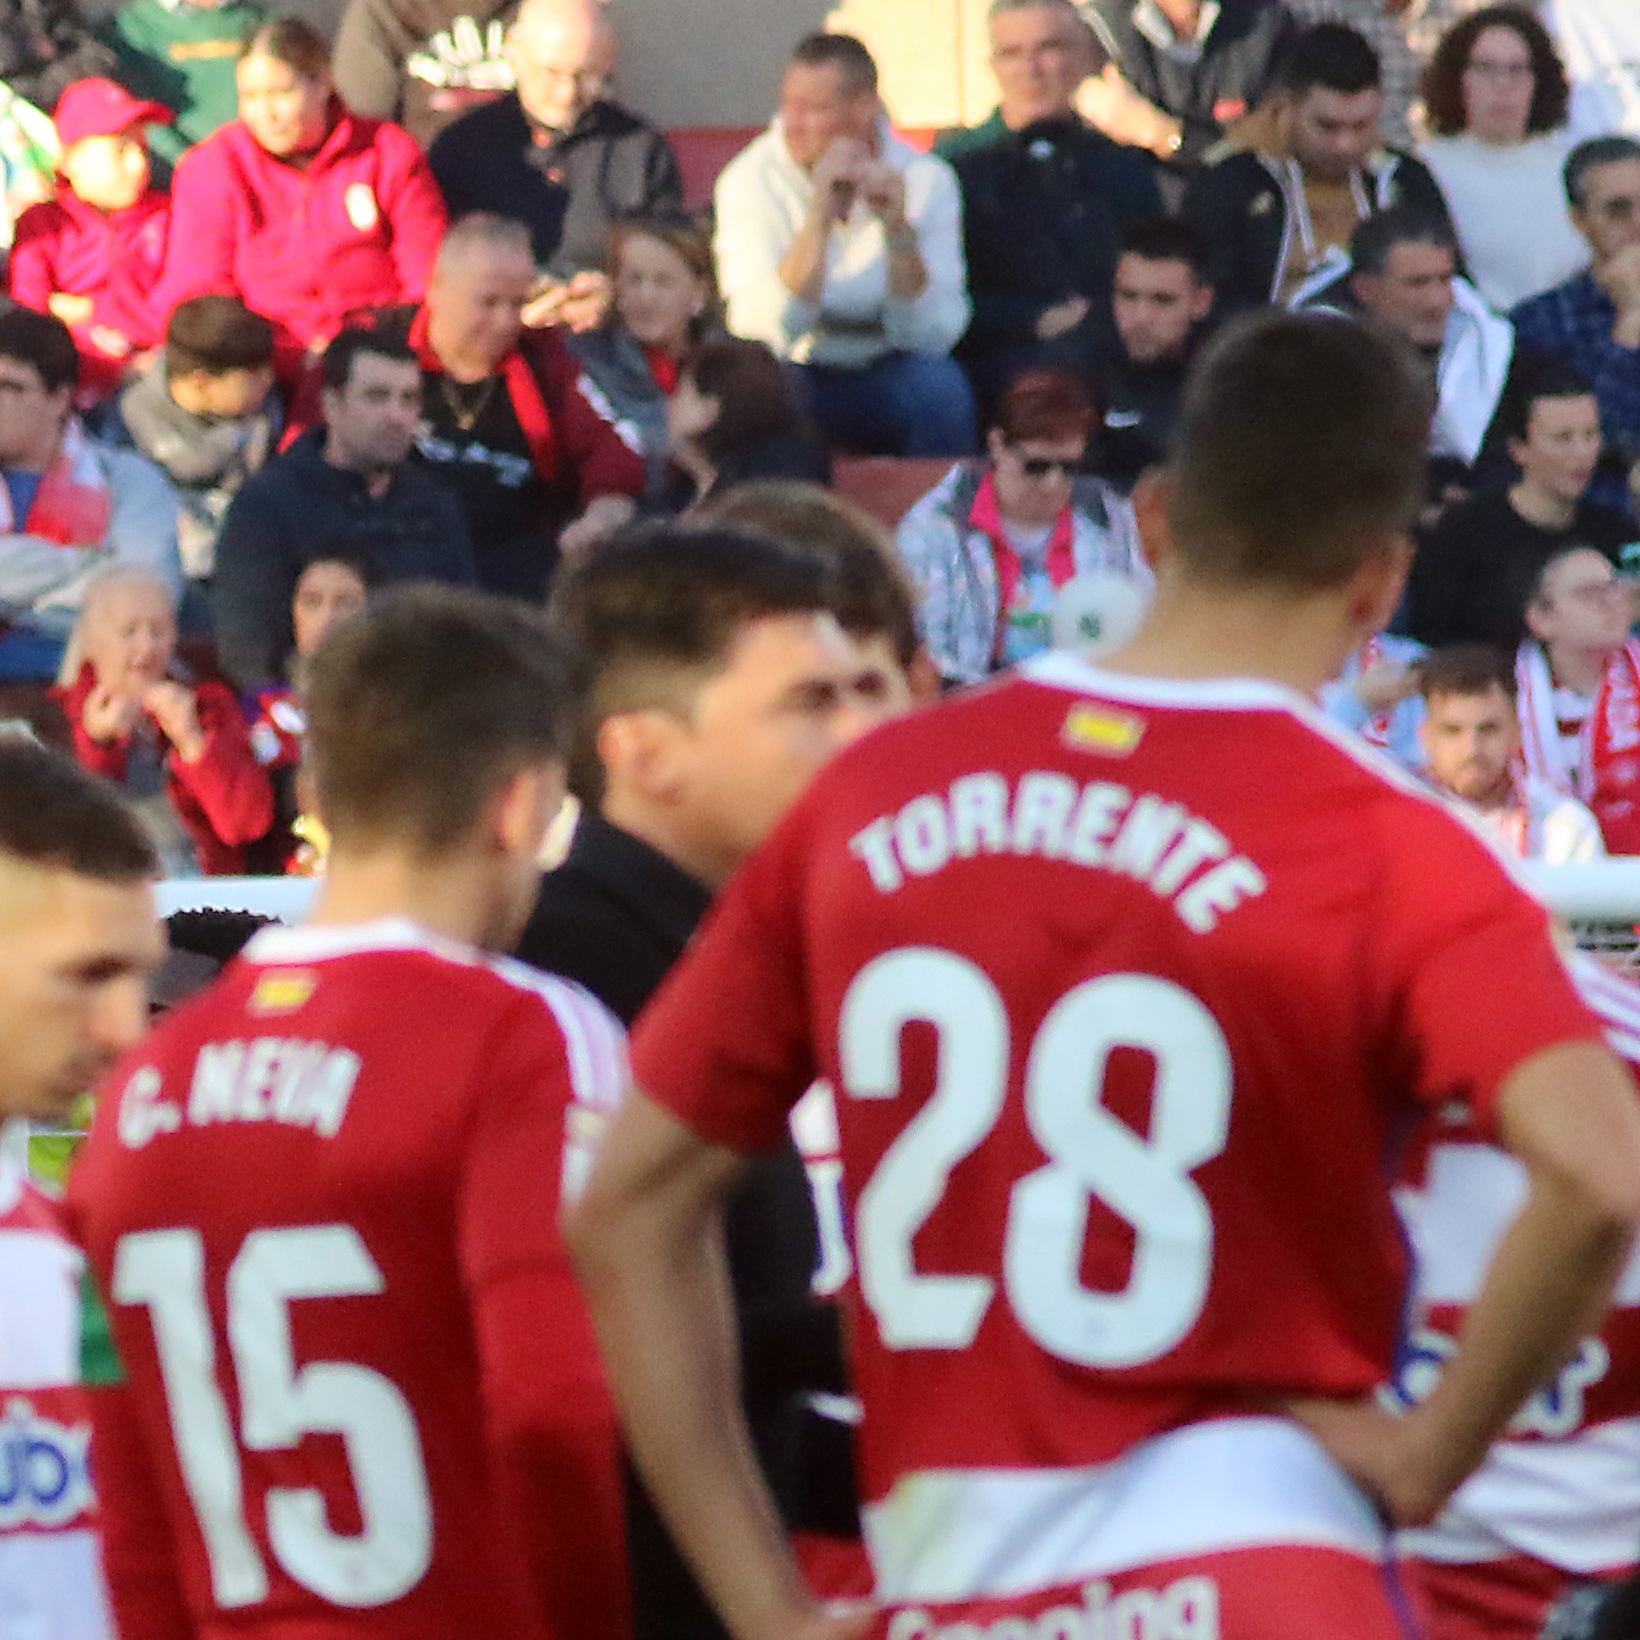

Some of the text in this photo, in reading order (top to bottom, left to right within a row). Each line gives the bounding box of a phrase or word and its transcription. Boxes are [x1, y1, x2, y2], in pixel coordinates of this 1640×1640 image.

[847, 769, 1268, 935] TORRENTE
[186, 1036, 363, 1140] NEVA
[837, 943, 1234, 1370] 28
[112, 1223, 433, 1610] 15
